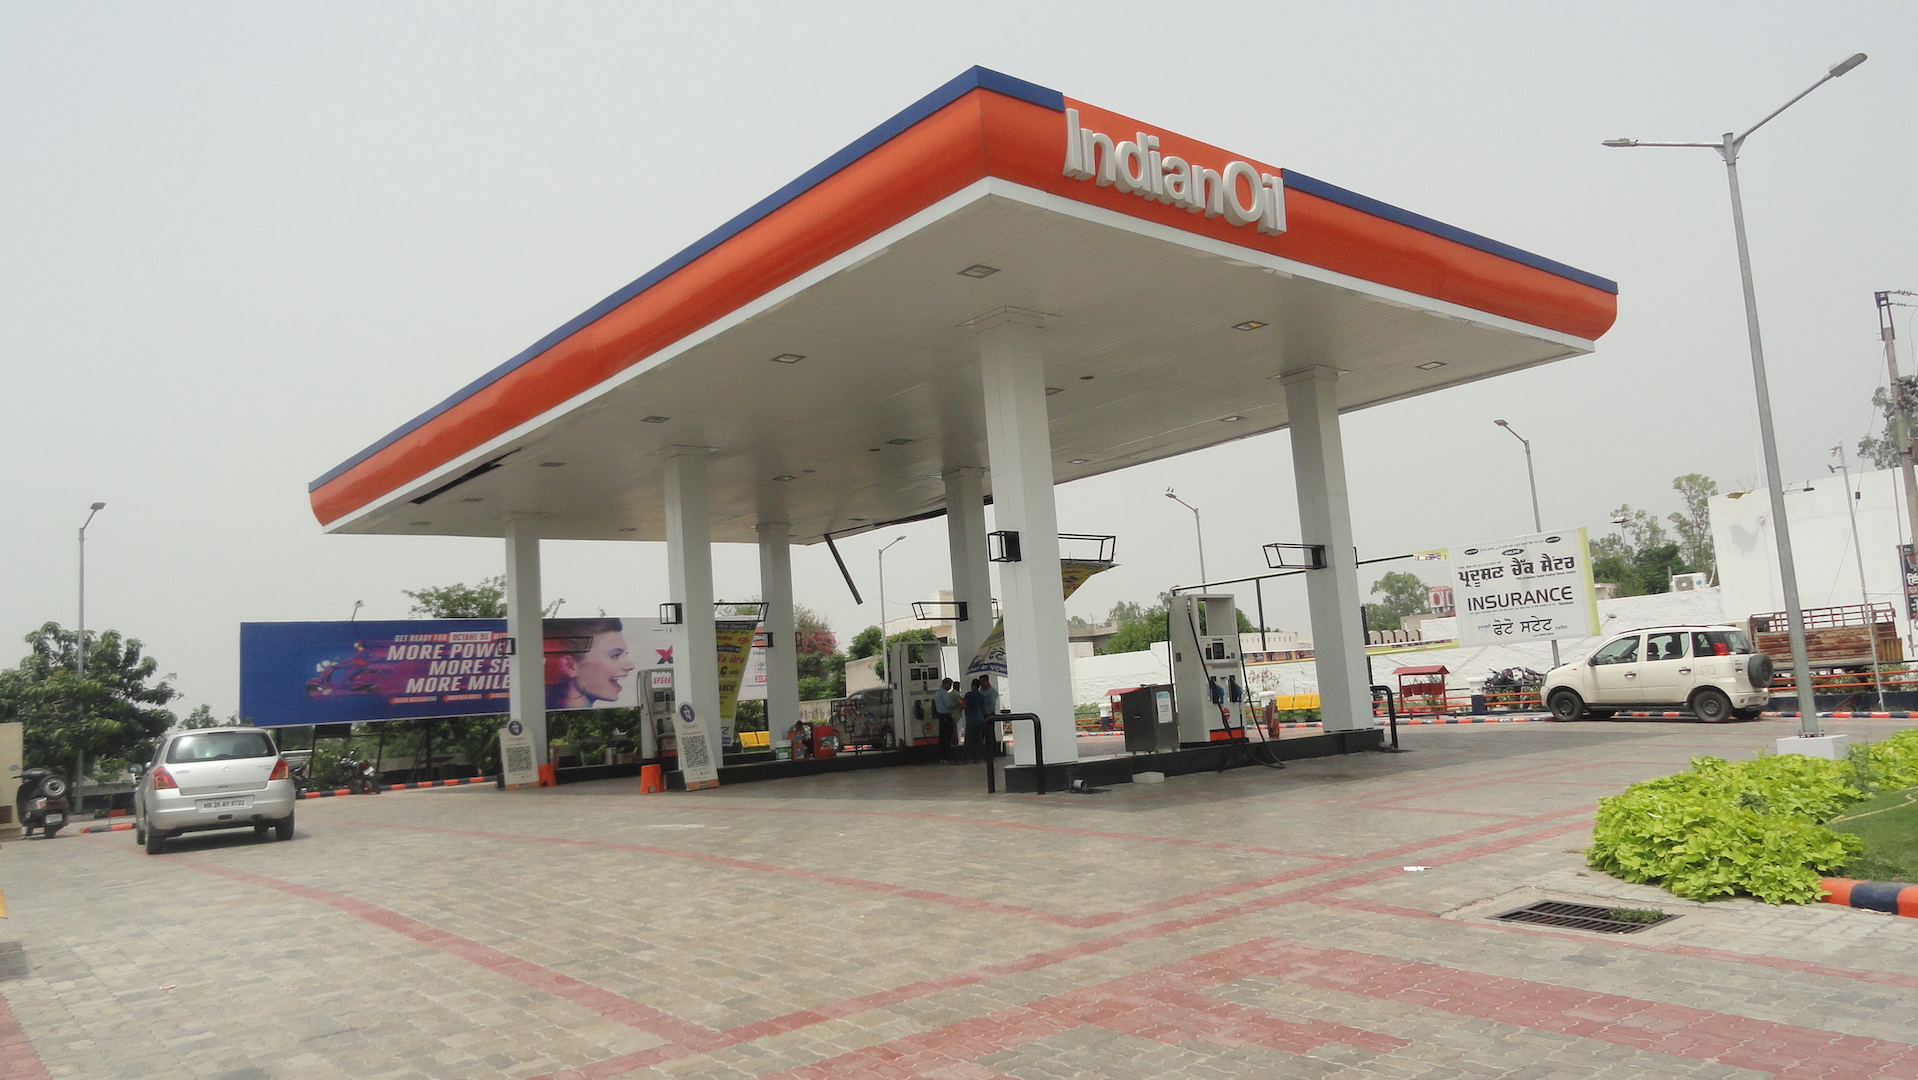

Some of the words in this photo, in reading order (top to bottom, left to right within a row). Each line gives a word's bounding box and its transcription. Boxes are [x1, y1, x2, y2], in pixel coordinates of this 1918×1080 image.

[1062, 108, 1287, 236] IndianOil
[1467, 586, 1573, 611] INSURANCE
[1520, 615, 1553, 633] ਸਟੇਟ
[387, 644, 445, 660] MORE
[428, 659, 485, 675] MORE
[405, 676, 463, 693] MORE
